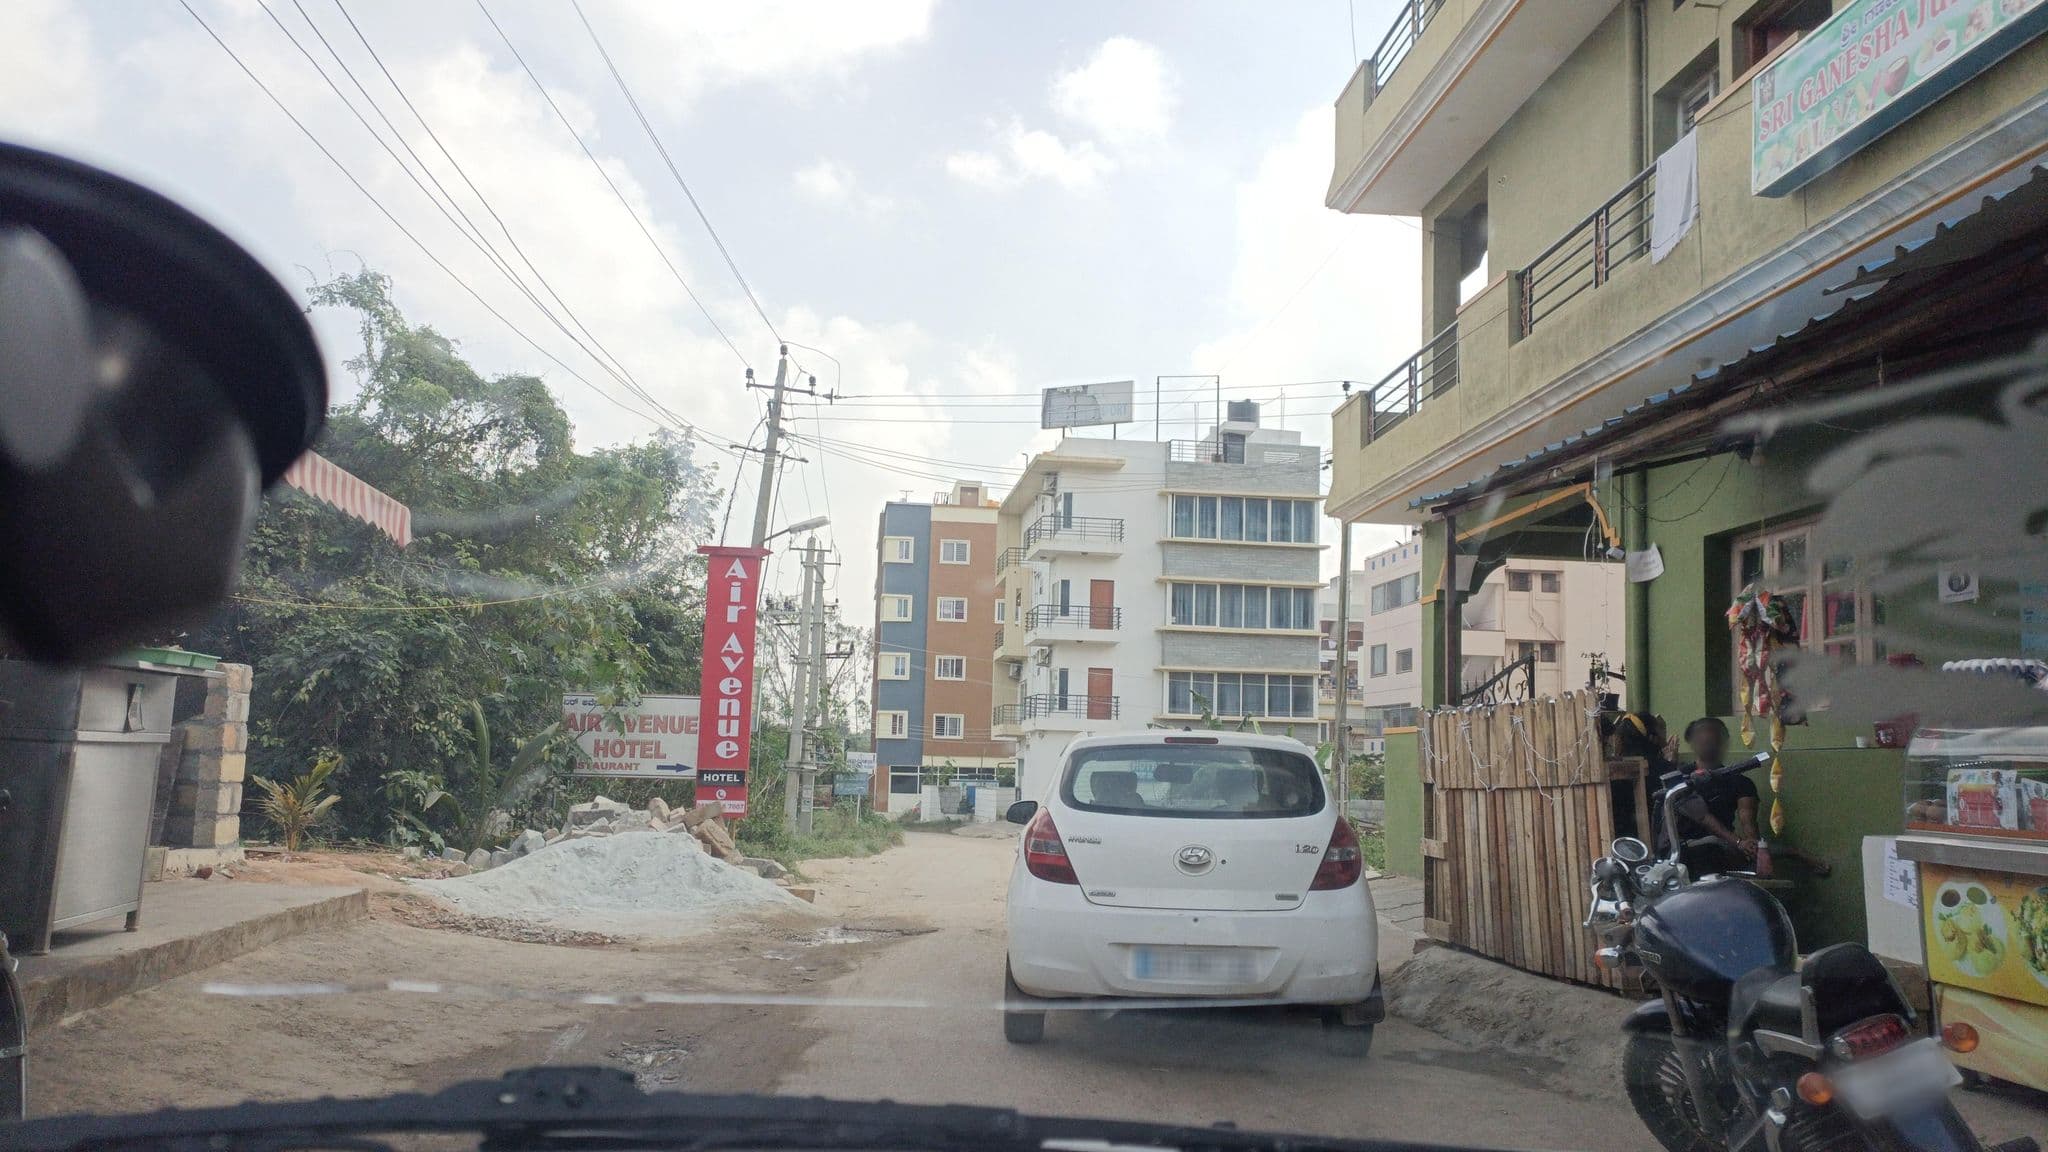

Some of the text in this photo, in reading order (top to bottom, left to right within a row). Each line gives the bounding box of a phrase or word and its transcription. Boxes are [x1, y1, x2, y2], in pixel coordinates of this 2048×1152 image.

[1759, 0, 1958, 142] SRI GANESHA JU
[715, 558, 748, 760] Air Avenue
[565, 712, 602, 732] AIR
[593, 739, 667, 759] HOTEL
[576, 762, 641, 771] STAURANT
[703, 773, 741, 782] HOTEL
